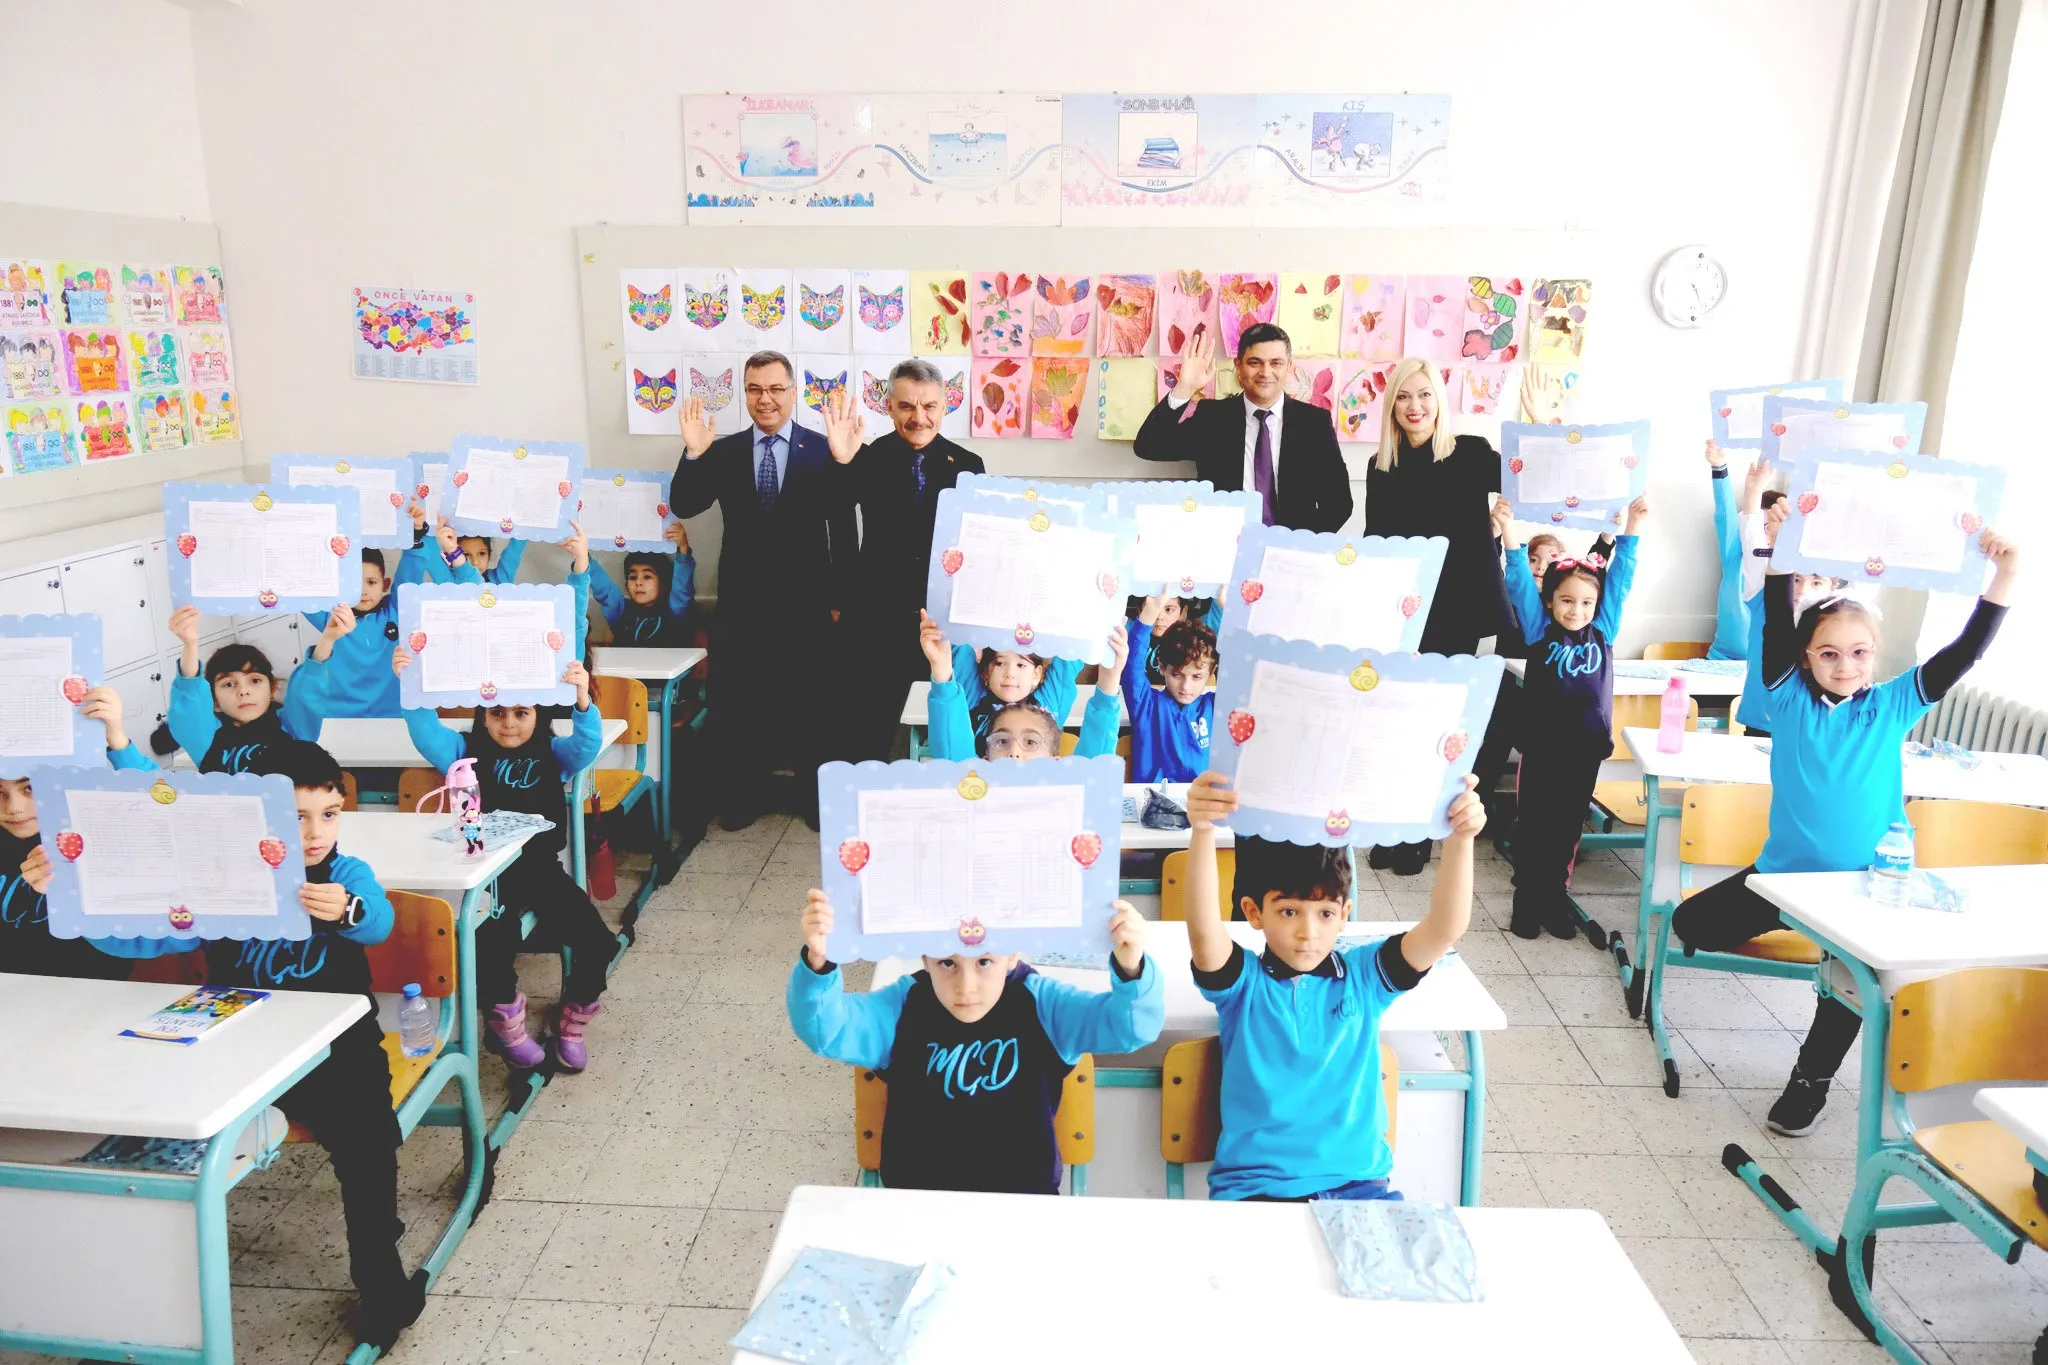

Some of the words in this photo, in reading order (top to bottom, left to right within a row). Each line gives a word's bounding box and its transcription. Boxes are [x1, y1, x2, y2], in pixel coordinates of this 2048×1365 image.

[1146, 178, 1168, 188] EKİM
[414, 293, 453, 303] VATAN
[1545, 641, 1603, 679] MCD
[926, 1036, 1021, 1101] MCD
